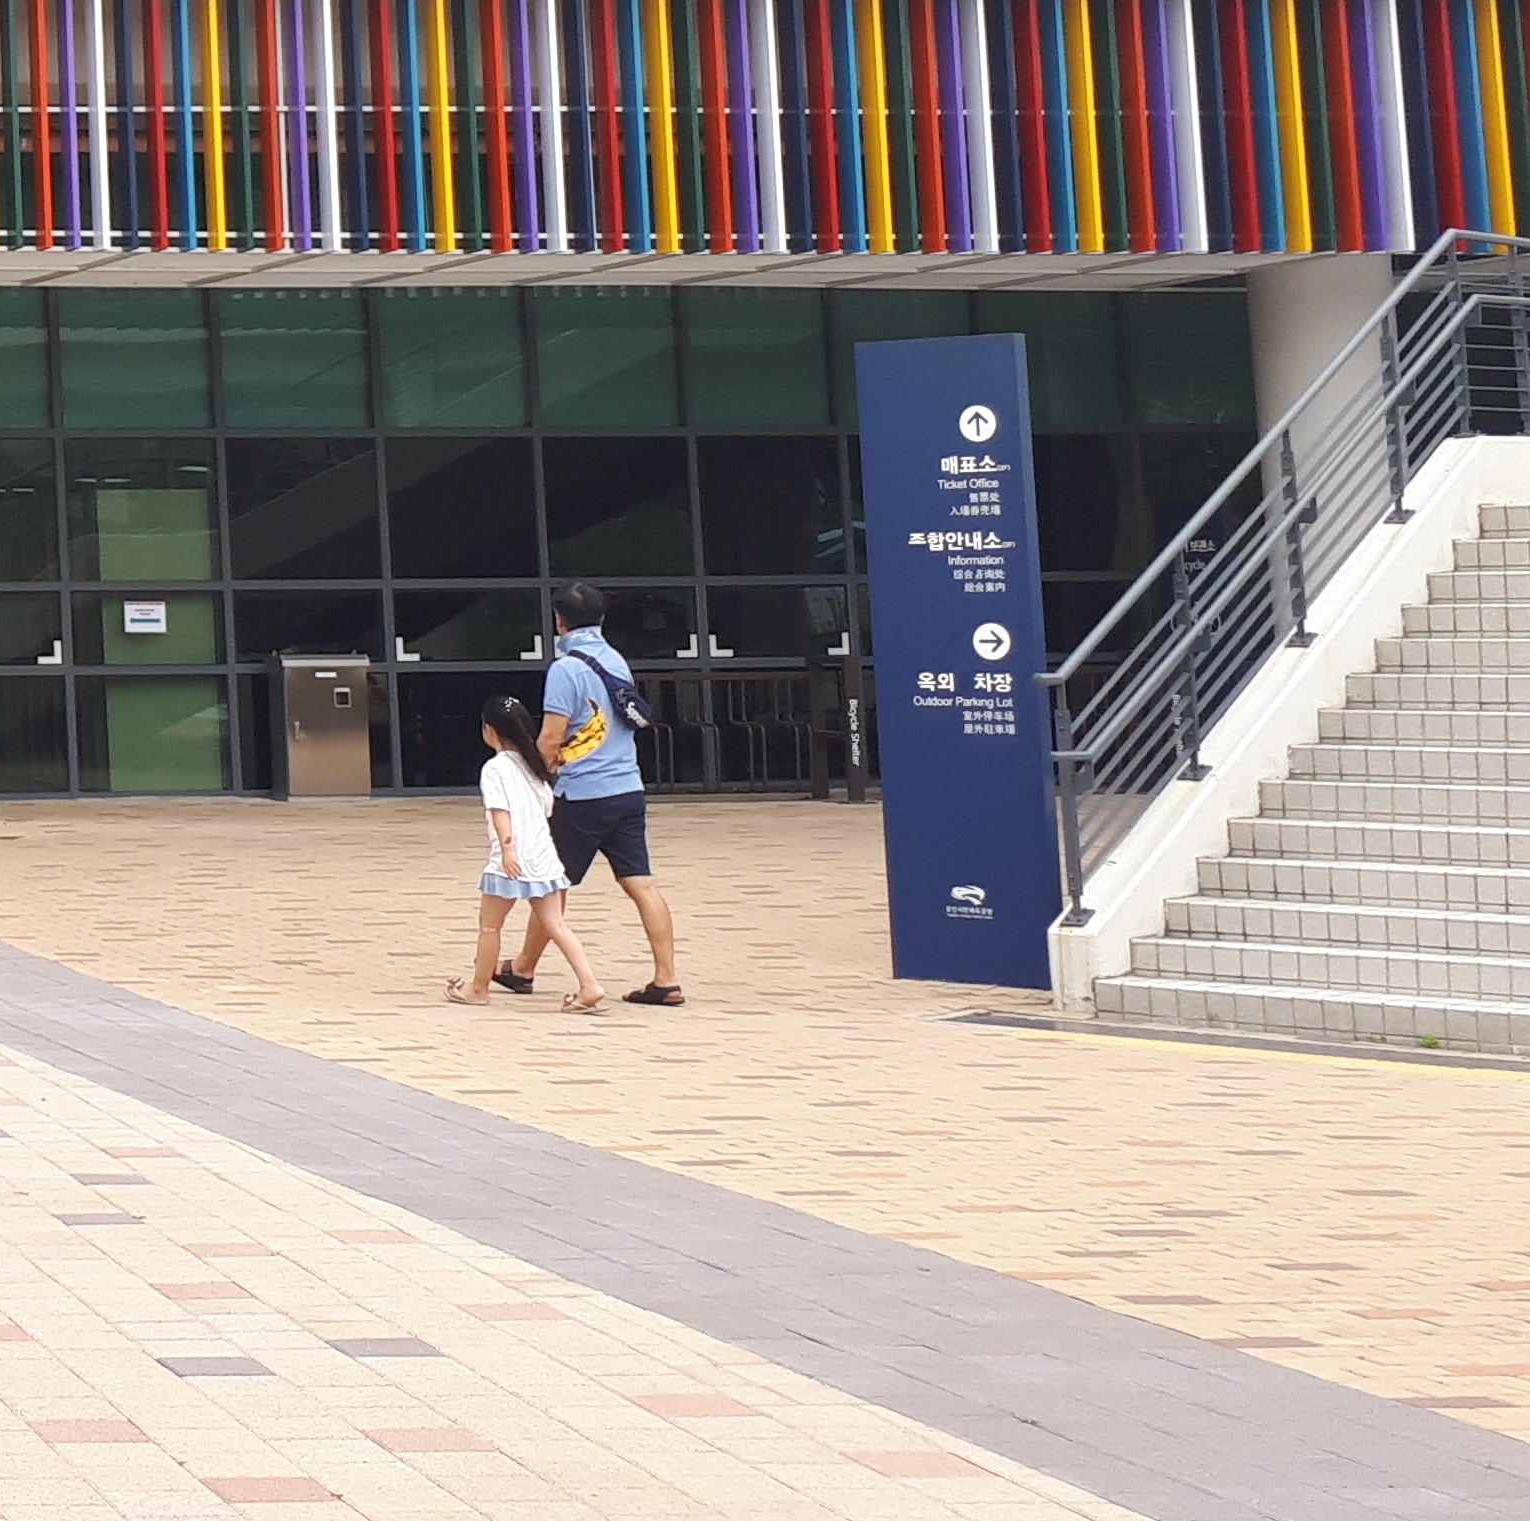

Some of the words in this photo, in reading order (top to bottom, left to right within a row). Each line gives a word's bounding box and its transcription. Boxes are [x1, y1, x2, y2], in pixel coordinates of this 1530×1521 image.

[940, 455, 998, 475] 매표소
[937, 479, 967, 490] Ticket
[969, 478, 999, 489] Office
[947, 555, 1005, 566] Information
[917, 672, 955, 692] 옥외
[913, 695, 954, 707] Outdoor
[955, 696, 994, 709] Parking
[996, 697, 1014, 708] Lot
[847, 698, 860, 731] Bicycle
[850, 732, 861, 767] Shelter
